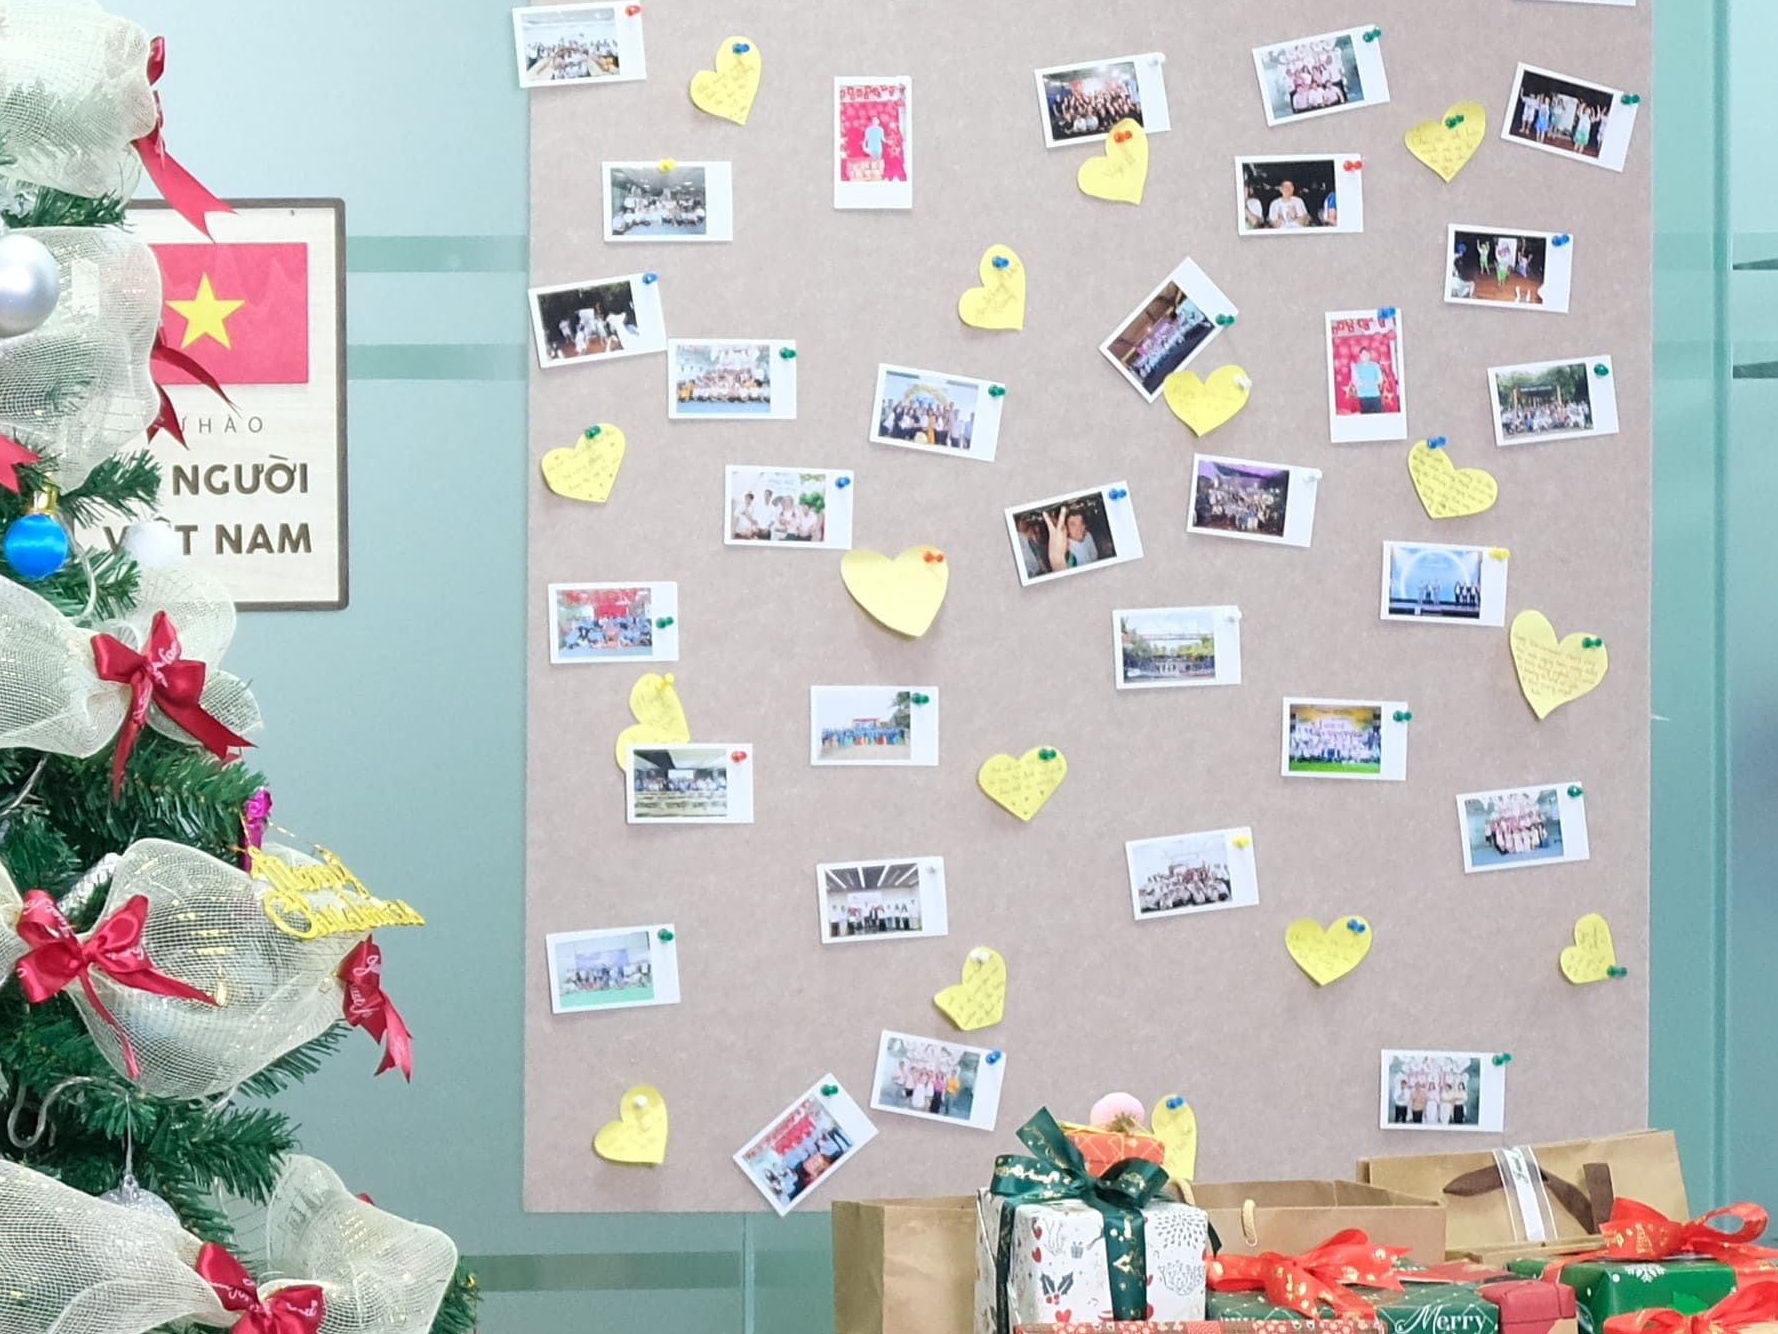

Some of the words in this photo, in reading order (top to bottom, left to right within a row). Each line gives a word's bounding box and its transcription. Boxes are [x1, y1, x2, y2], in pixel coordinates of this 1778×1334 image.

[172, 454, 309, 496] NGƯỜI
[103, 517, 198, 556] VT
[215, 523, 312, 555] NAM
